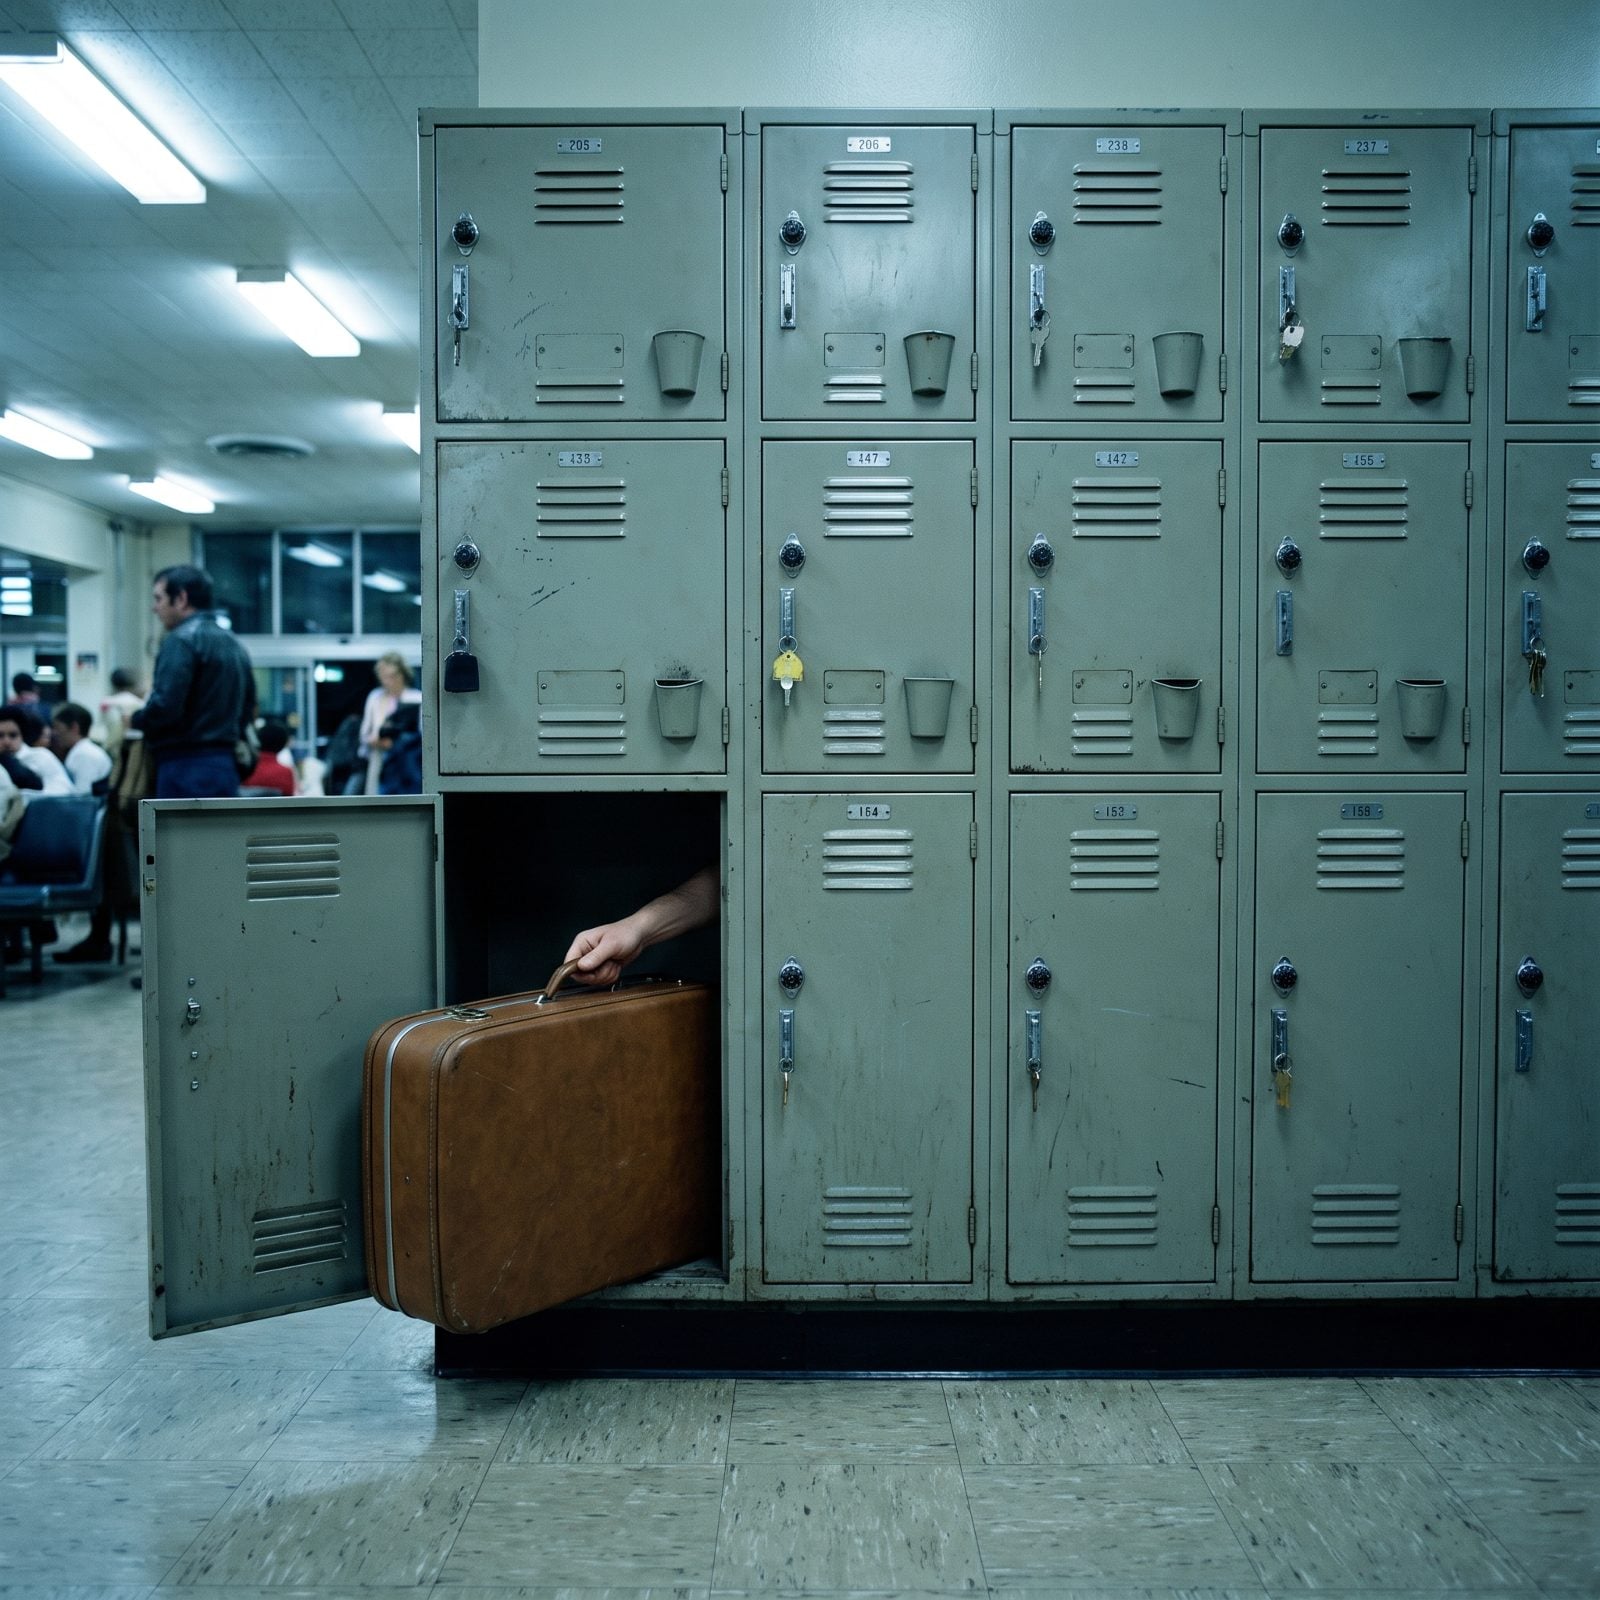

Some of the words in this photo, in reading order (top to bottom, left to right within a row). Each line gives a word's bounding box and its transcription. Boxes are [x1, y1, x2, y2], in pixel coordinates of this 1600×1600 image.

[569, 139, 590, 151] 205
[859, 140, 879, 150] 206
[1108, 140, 1128, 151] 238
[1356, 141, 1376, 152] 237
[859, 806, 878, 817] 164
